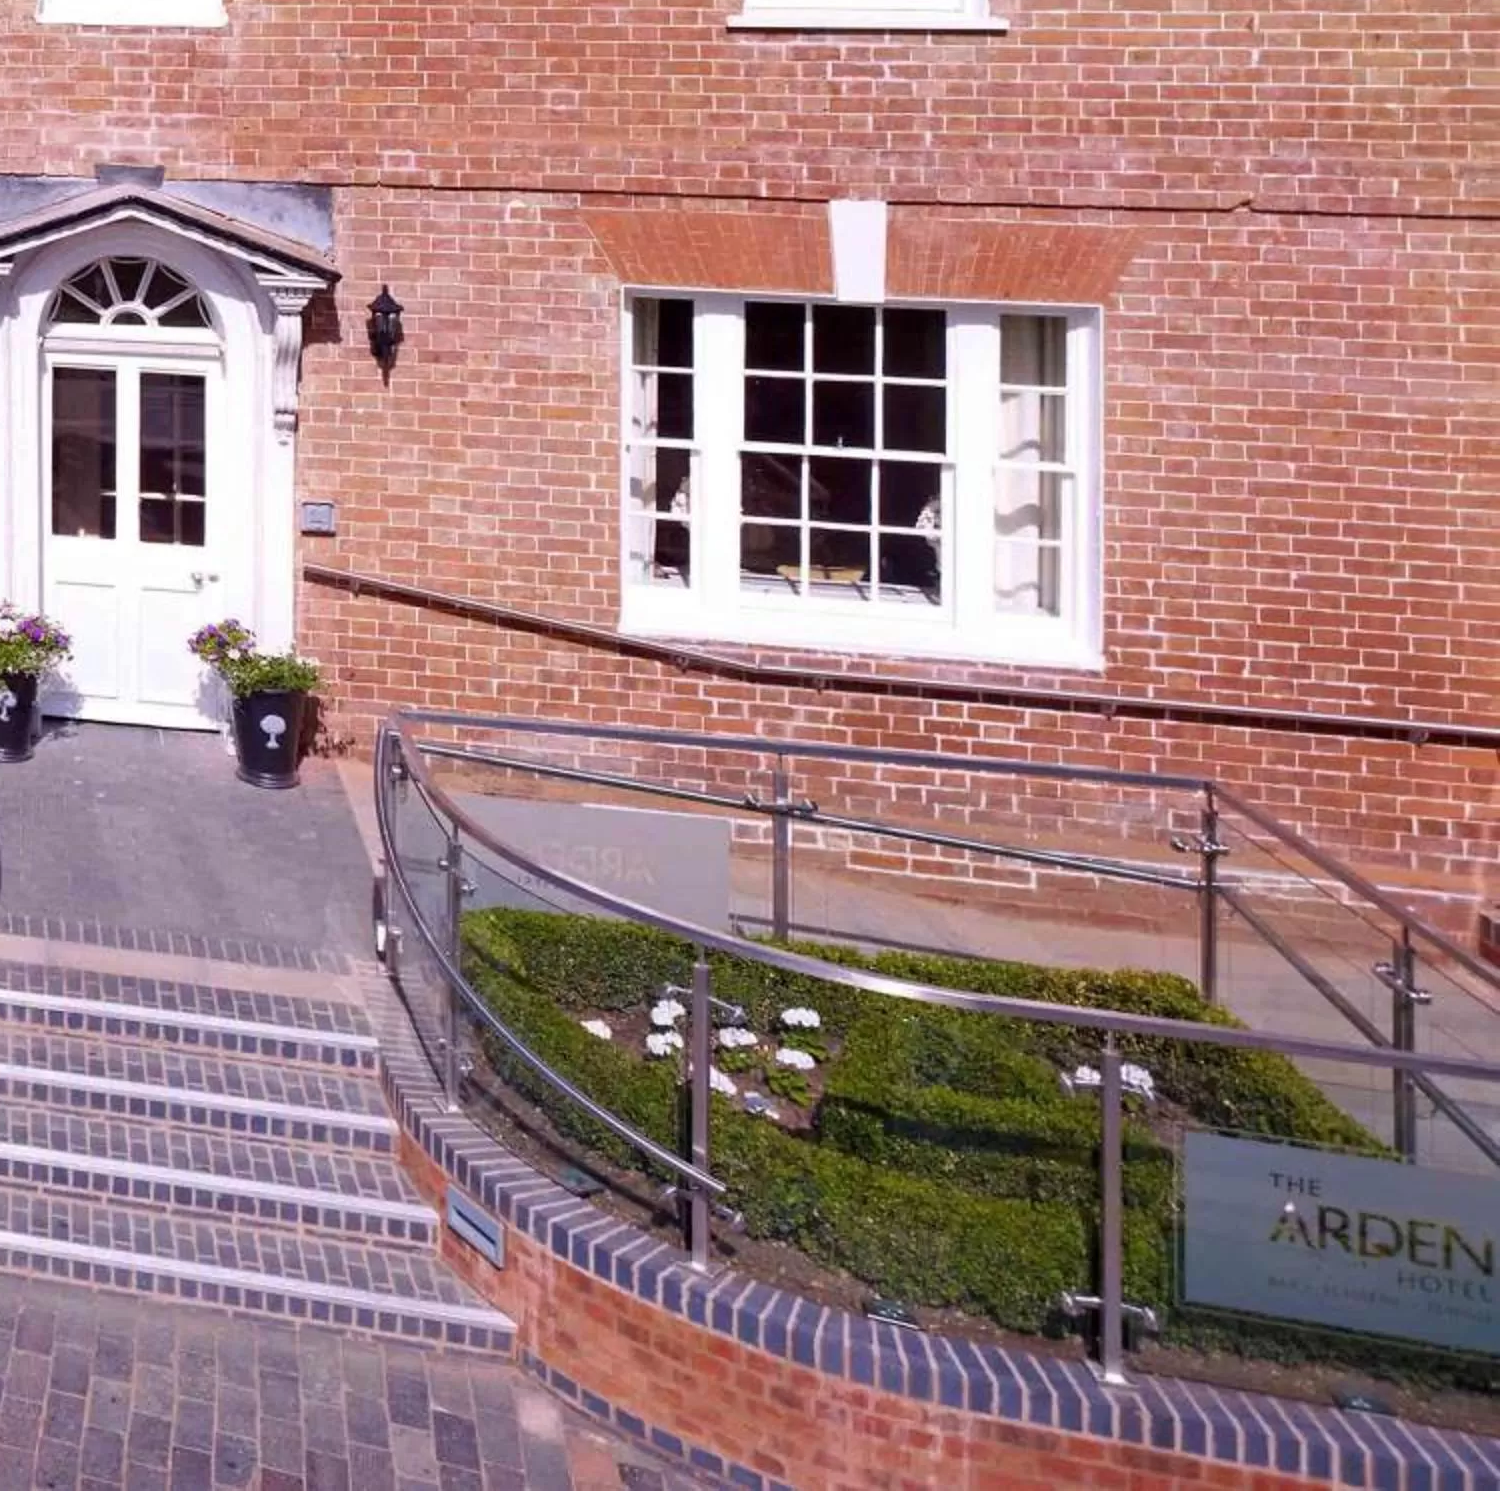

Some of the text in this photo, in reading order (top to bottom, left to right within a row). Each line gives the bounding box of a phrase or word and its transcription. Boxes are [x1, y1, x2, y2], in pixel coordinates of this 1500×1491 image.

[1268, 1171, 1323, 1198] THE
[1268, 1204, 1494, 1277] ARDEN
[1396, 1271, 1494, 1304] HOTEL
